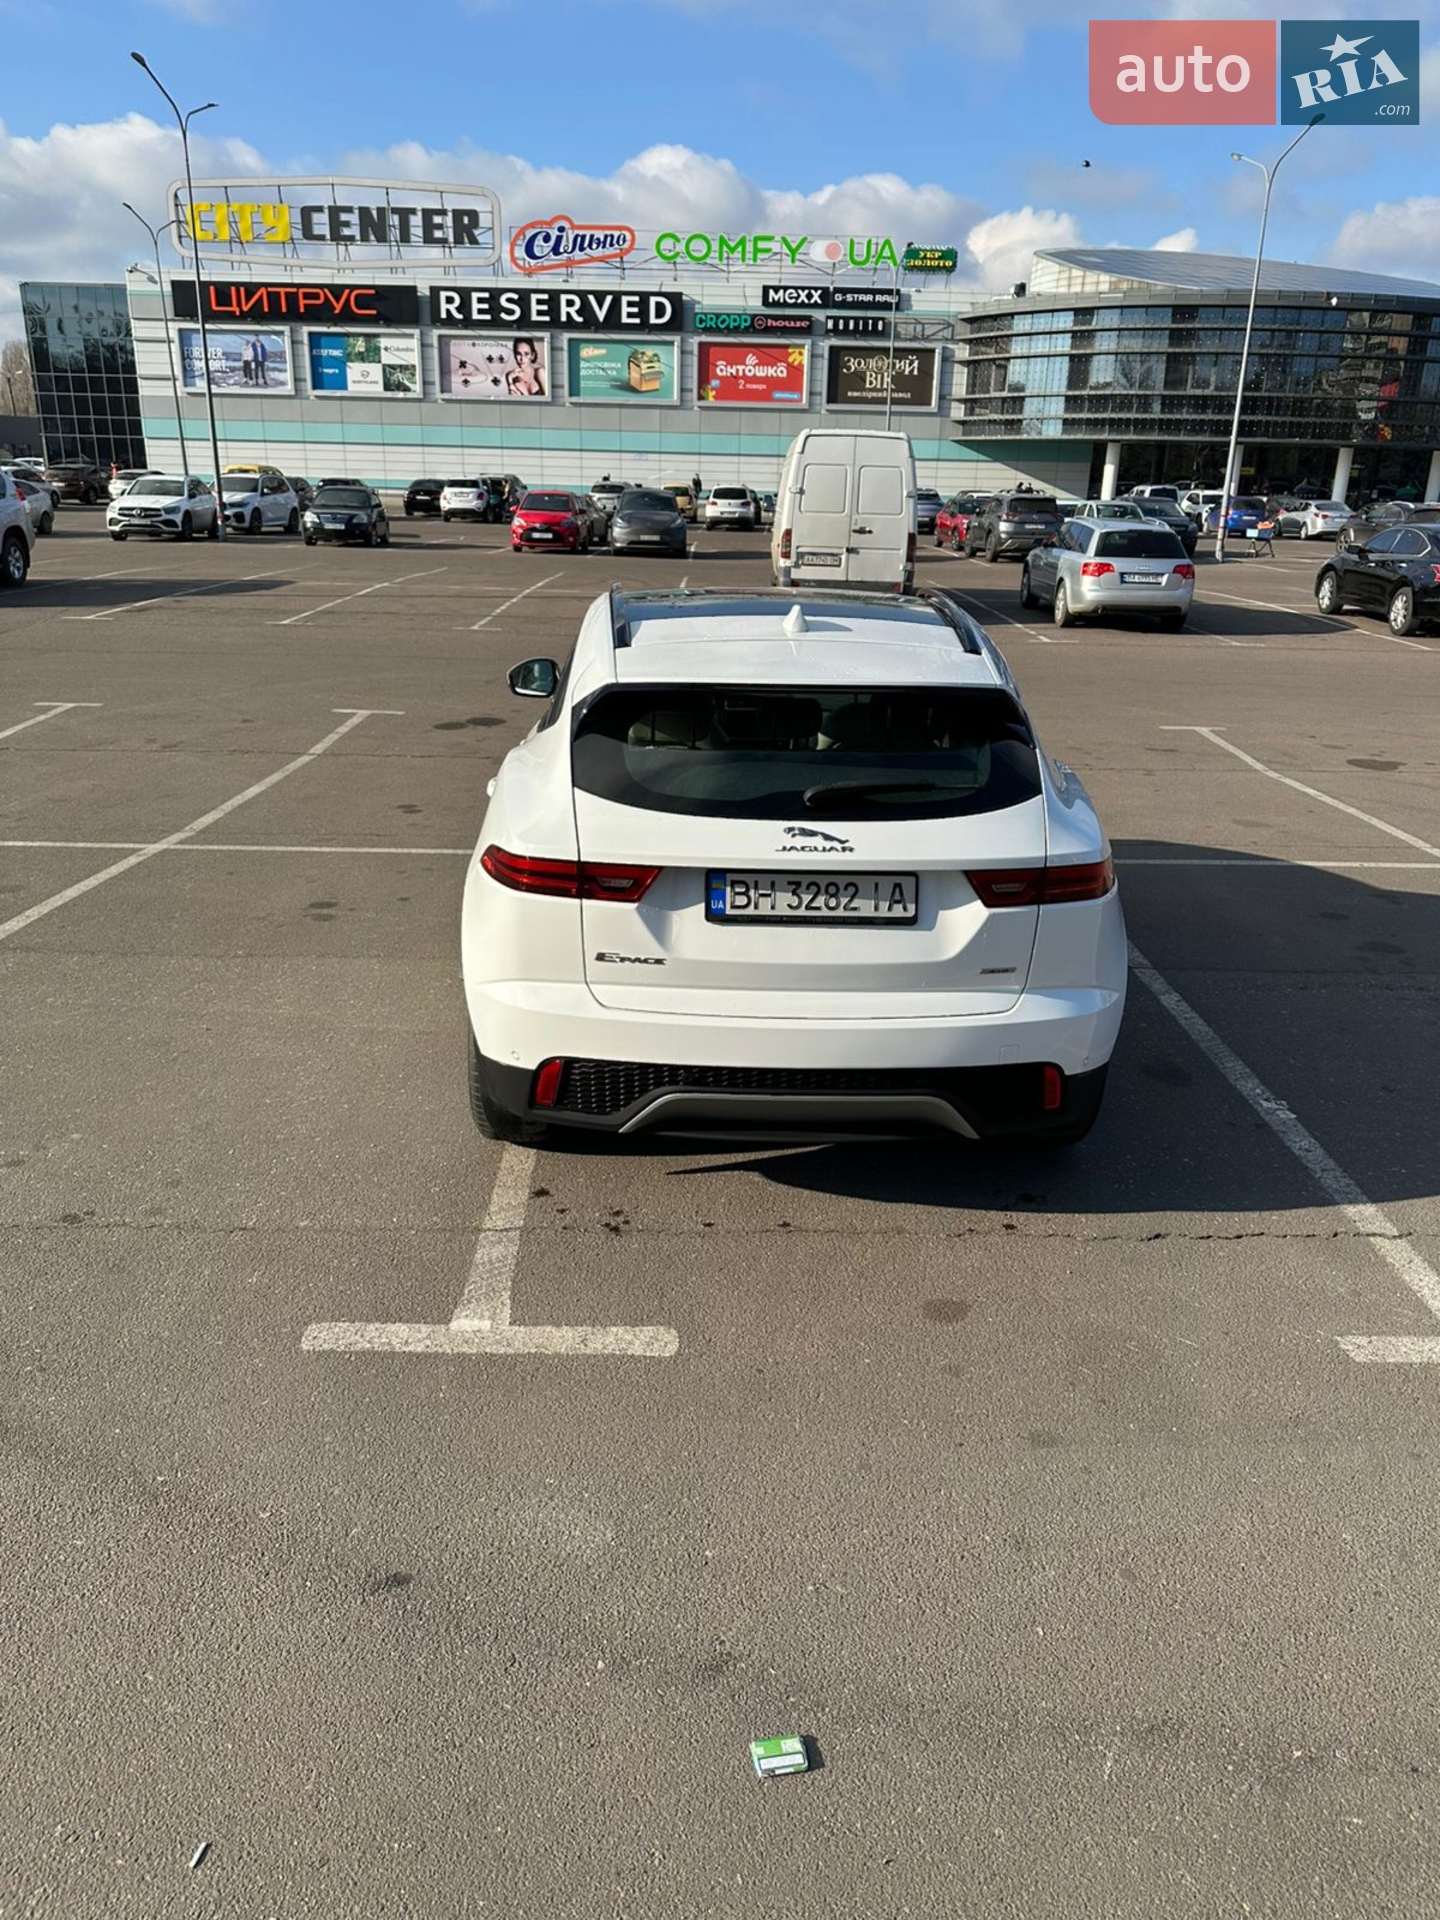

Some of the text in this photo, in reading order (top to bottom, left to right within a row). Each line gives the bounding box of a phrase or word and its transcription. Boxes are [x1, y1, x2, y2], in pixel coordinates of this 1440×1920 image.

[187, 203, 481, 246] CITY CENTER
[524, 225, 627, 260] Сільпо
[655, 232, 899, 267] COMFY UA
[209, 285, 378, 316] ЦИТРУС
[439, 290, 673, 325] RESERVED
[834, 293, 899, 303] G-STAR RAW
[695, 314, 752, 329] CROPP
[185, 359, 230, 373] COMORT.
[738, 379, 745, 389] 2
[775, 845, 855, 853] JAGUAR
[710, 879, 909, 913] UA BH 3282 IA
